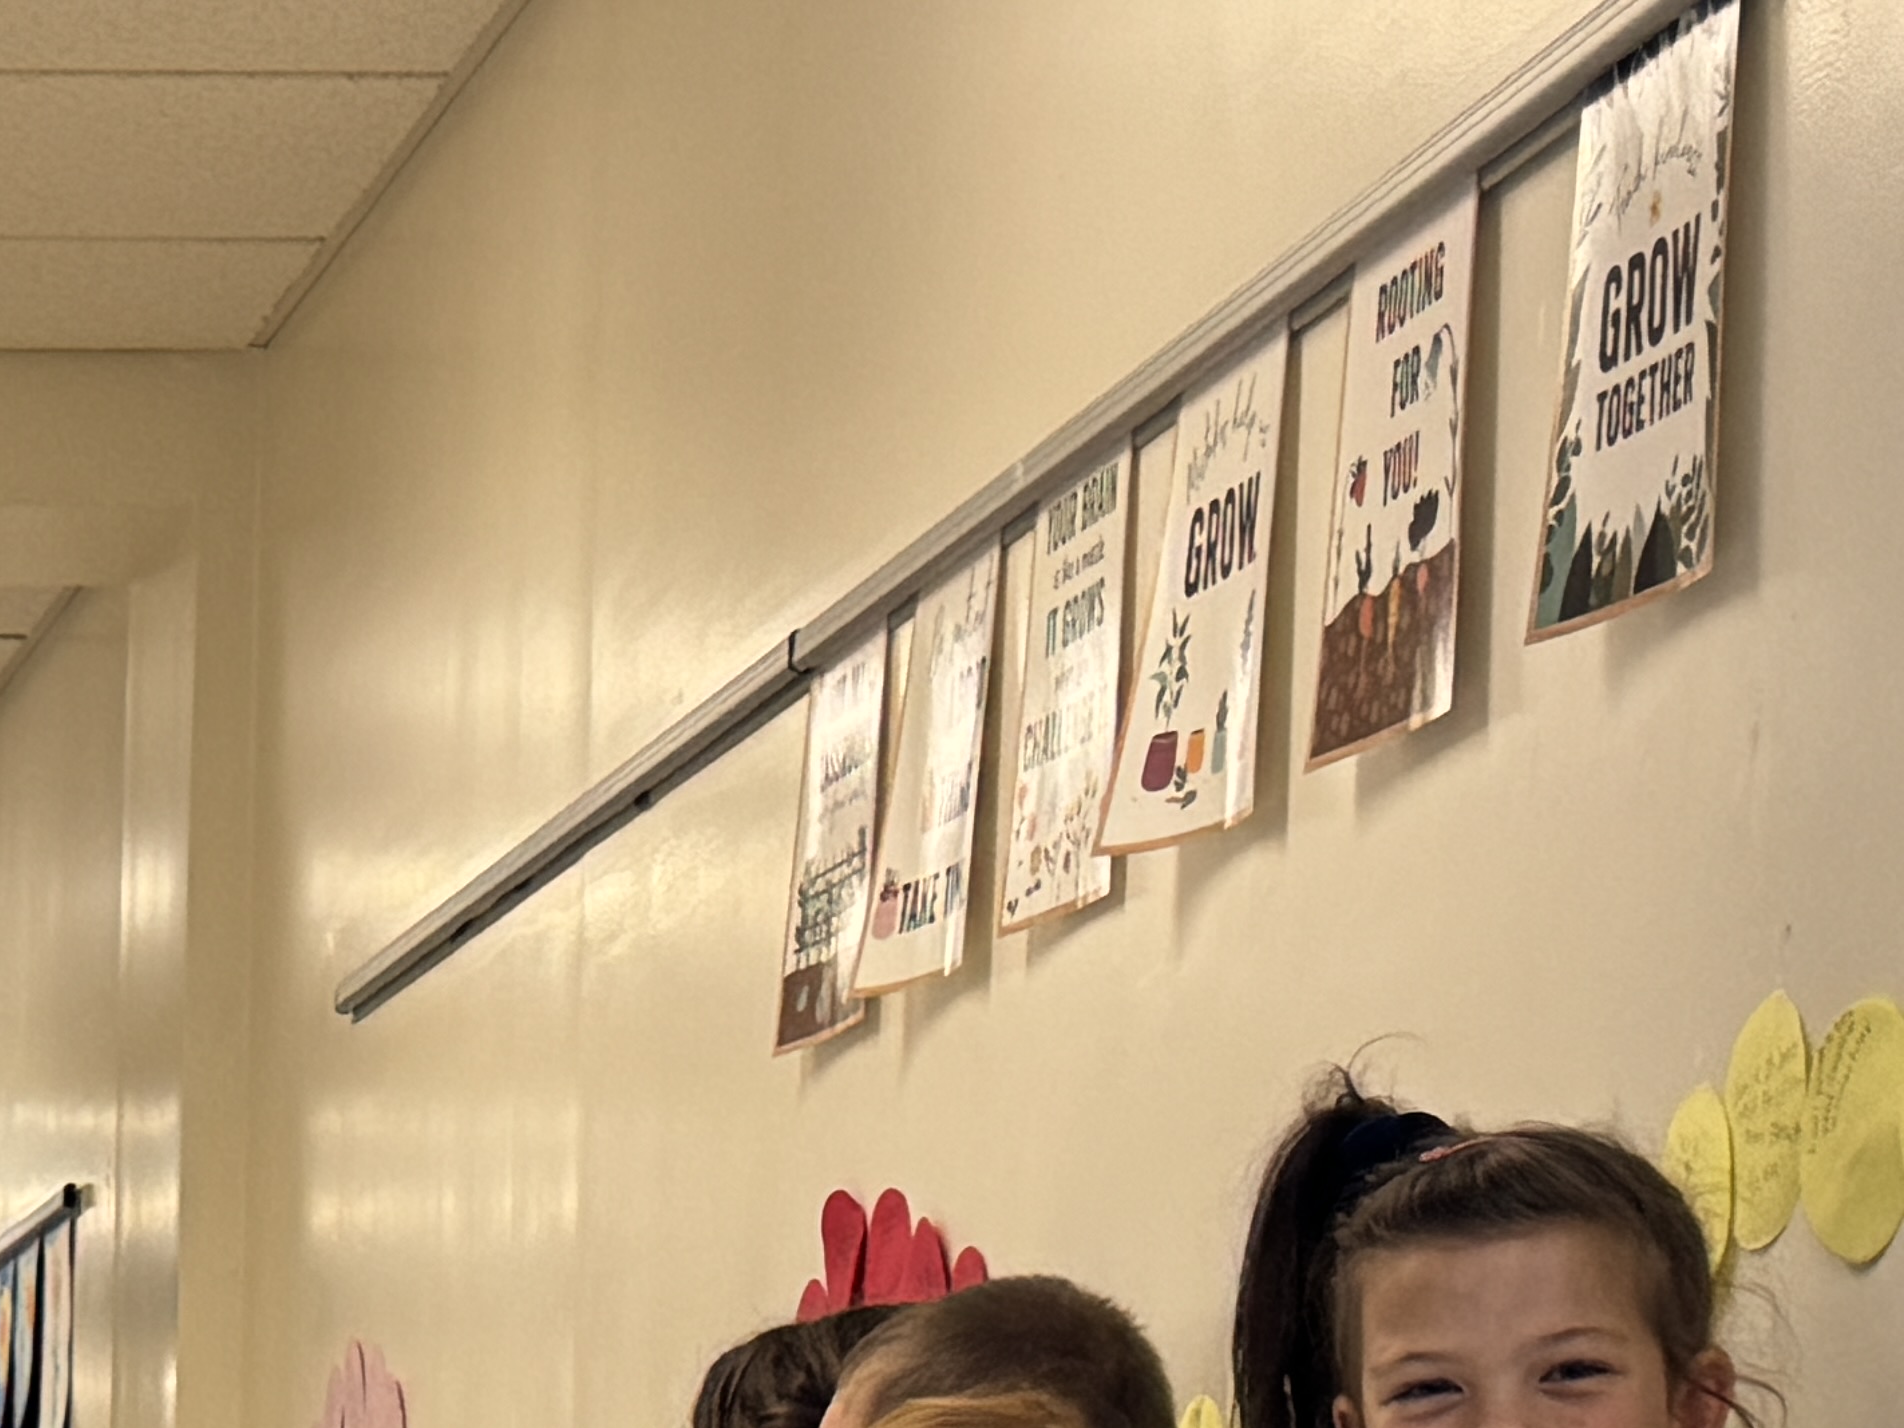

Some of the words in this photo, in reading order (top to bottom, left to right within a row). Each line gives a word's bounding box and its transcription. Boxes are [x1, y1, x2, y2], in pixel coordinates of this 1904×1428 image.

[1376, 241, 1445, 343] ROOTING
[1599, 211, 1701, 375] GROW
[1390, 345, 1421, 418] FOR
[1595, 341, 1696, 452] TOGETHER
[1383, 430, 1420, 507] YOU!
[898, 872, 940, 935] TAKE
